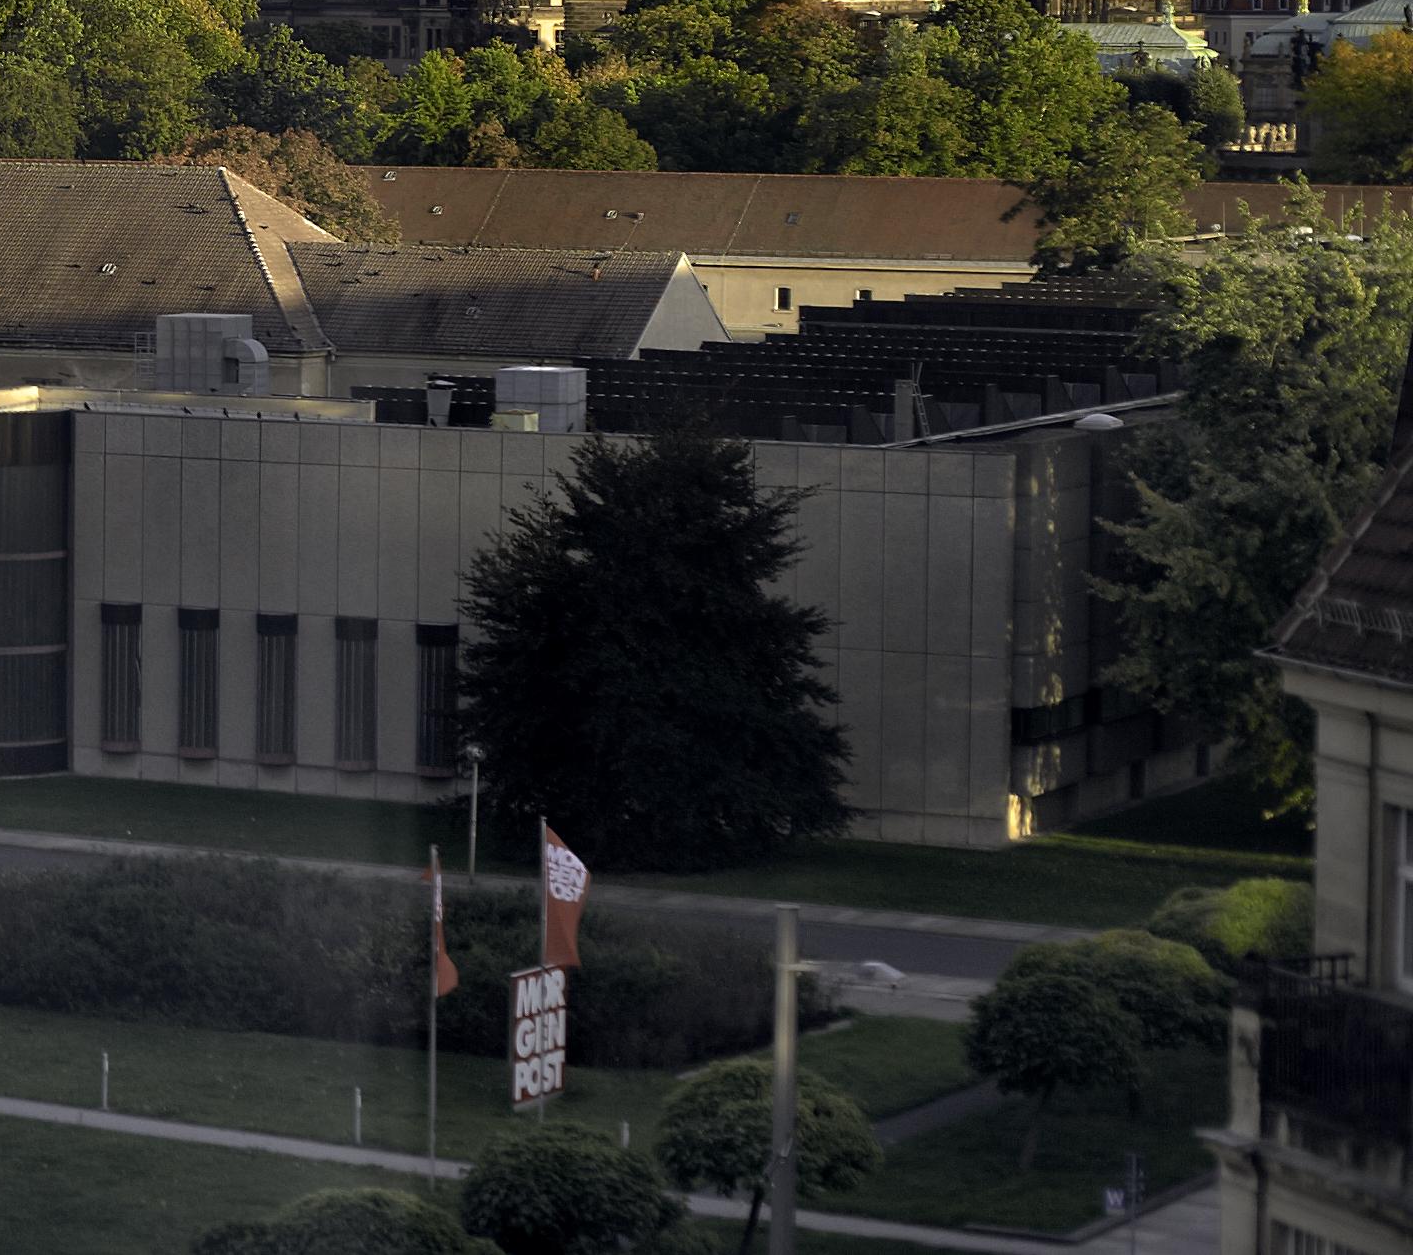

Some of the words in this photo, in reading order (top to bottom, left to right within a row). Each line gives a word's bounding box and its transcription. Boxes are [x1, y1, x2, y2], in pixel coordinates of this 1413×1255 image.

[516, 968, 566, 1018] MOR
[516, 1009, 566, 1058] GEN
[515, 1049, 565, 1101] POST
